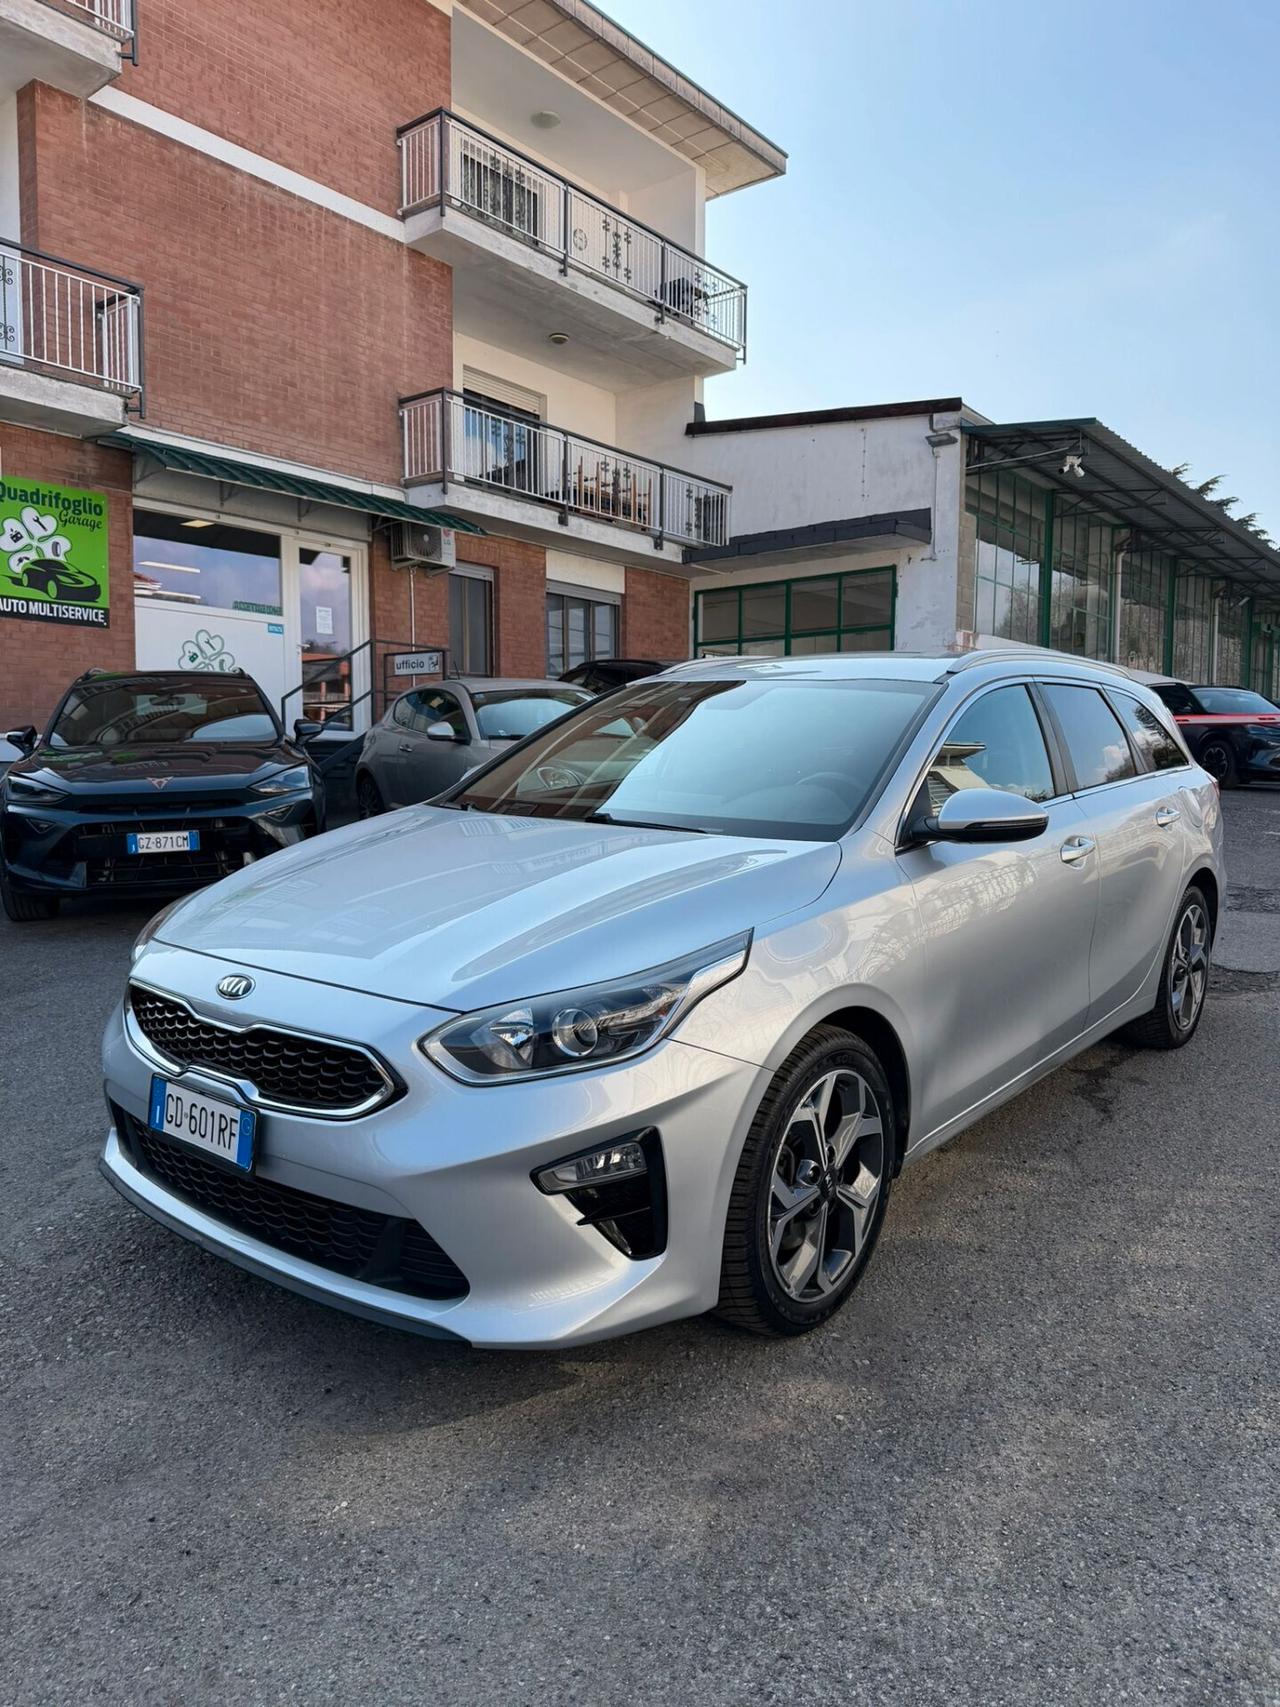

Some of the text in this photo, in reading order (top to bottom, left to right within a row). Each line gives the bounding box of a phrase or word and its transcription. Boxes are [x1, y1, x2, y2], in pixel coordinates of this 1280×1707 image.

[59, 509, 103, 532] Garage
[29, 601, 105, 622] MULTISERVICE
[396, 660, 425, 670] ufficio
[219, 976, 248, 995] KIA
